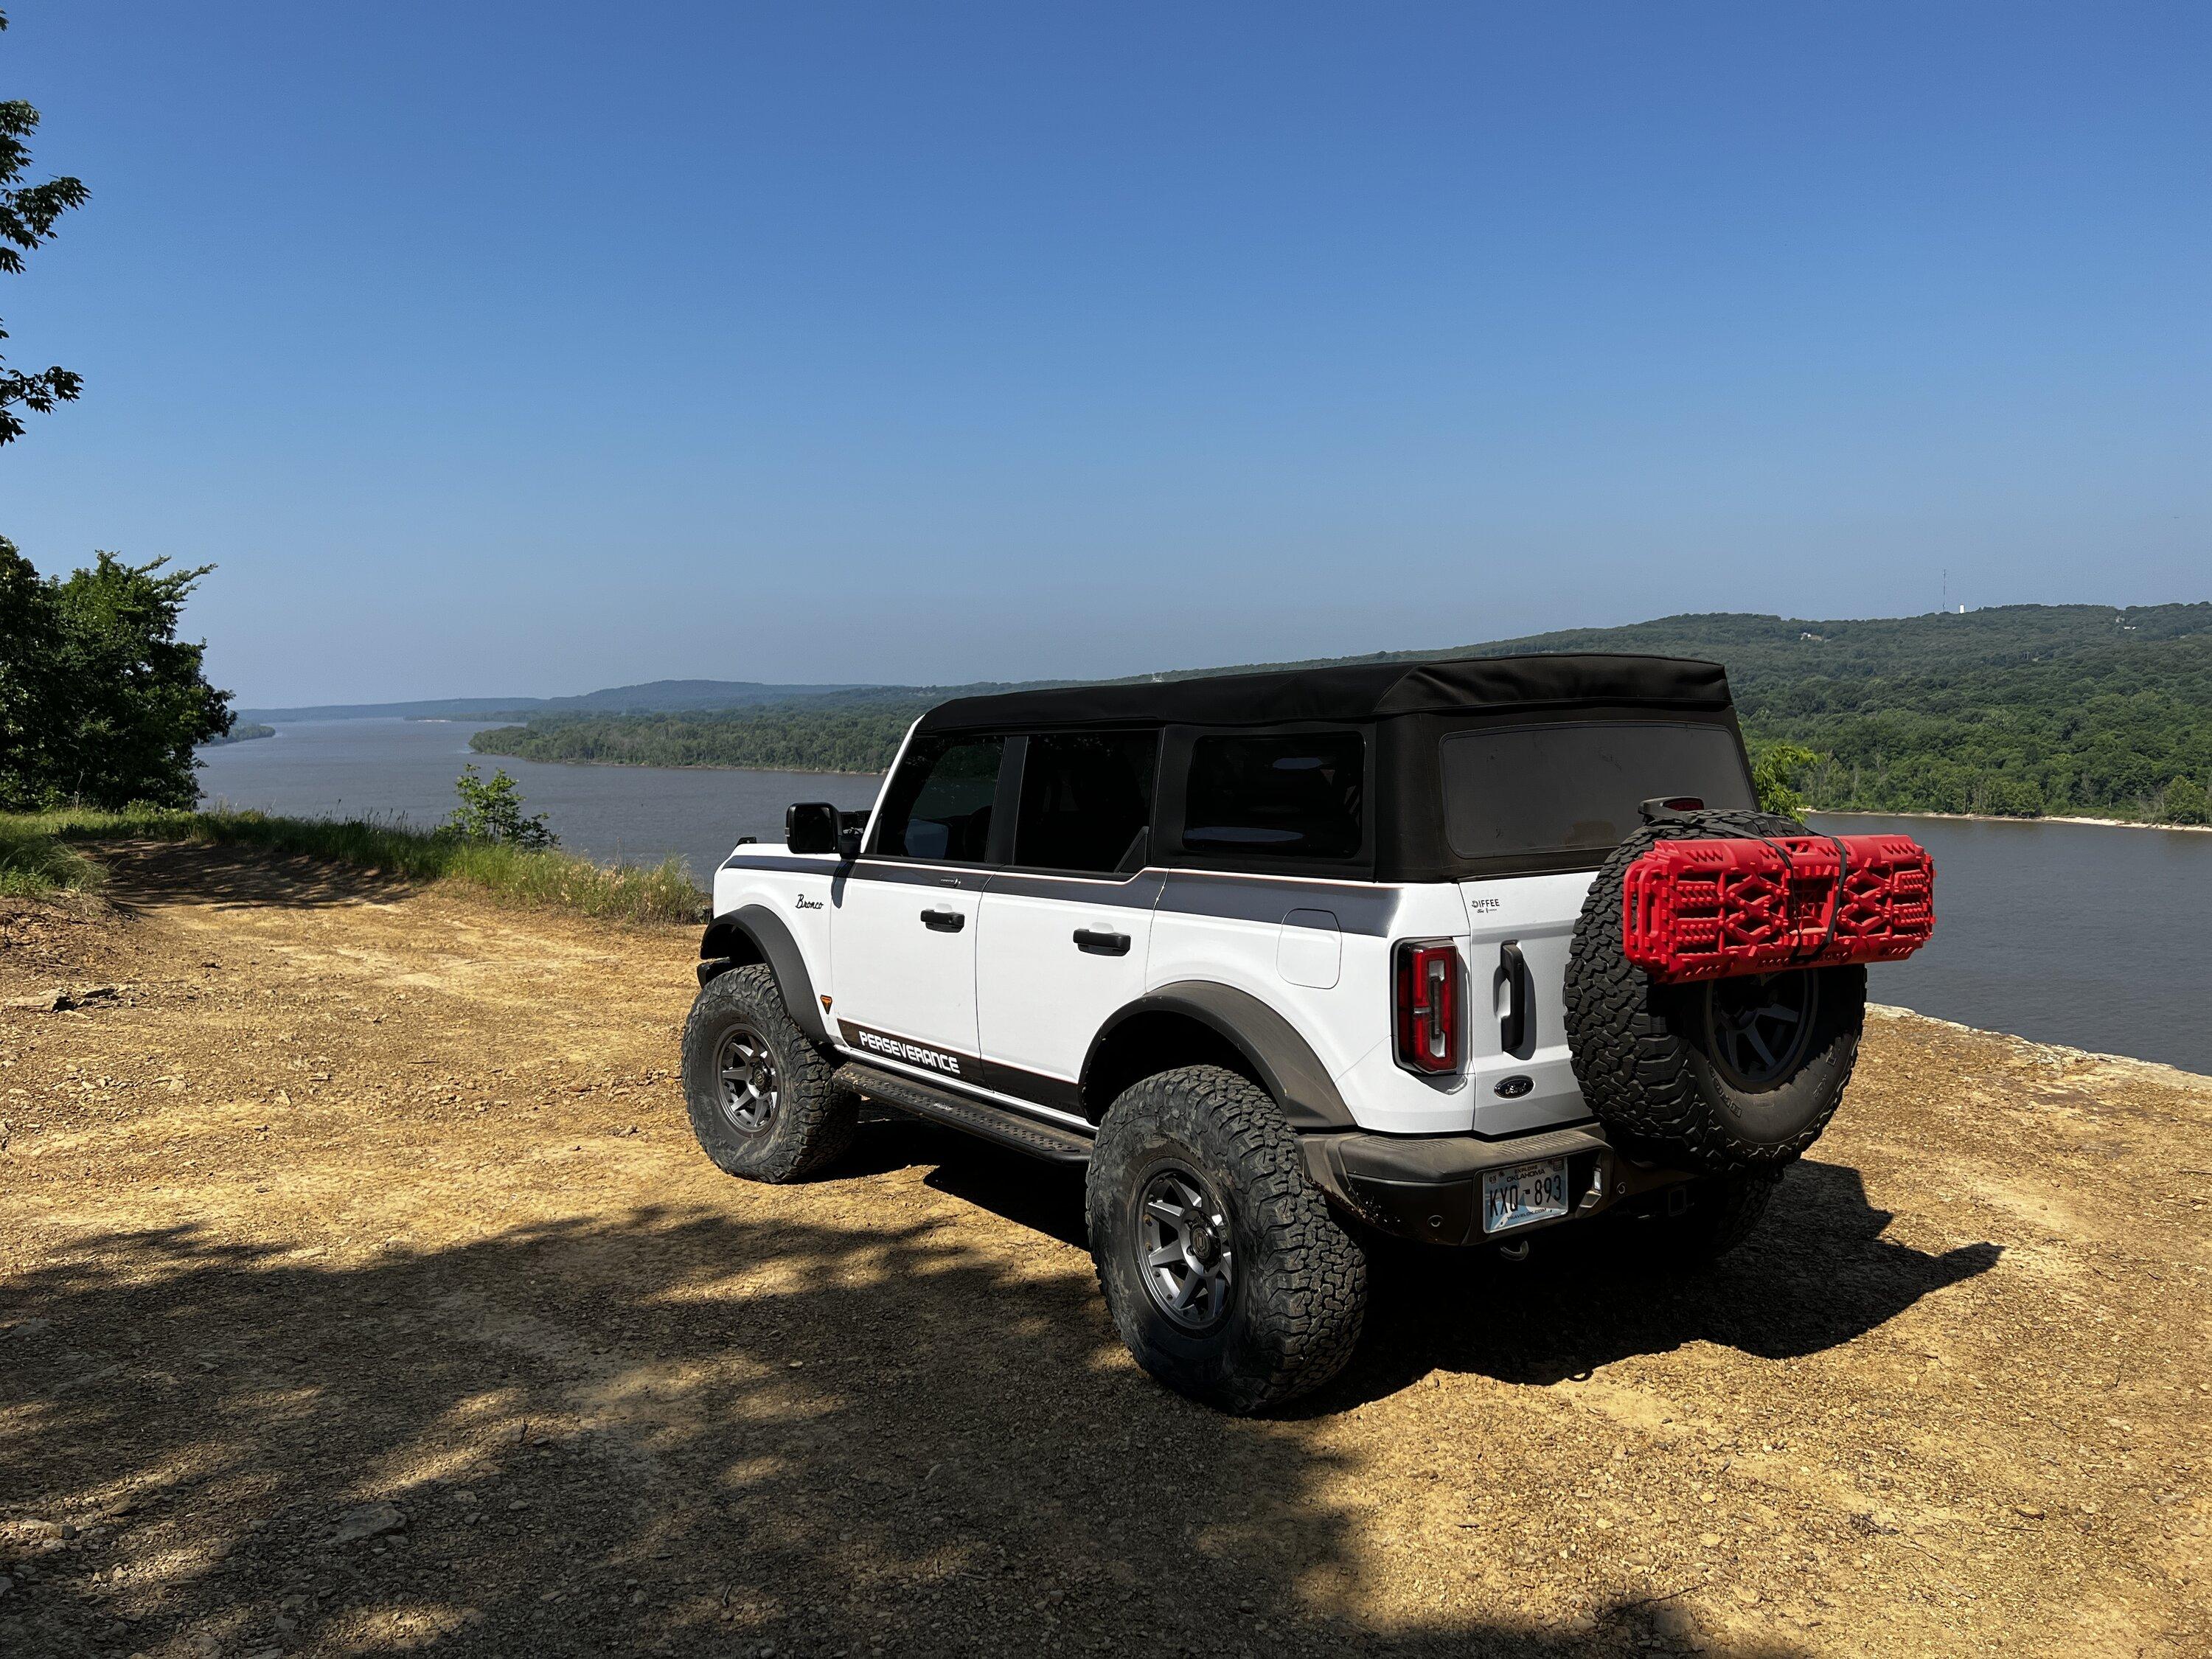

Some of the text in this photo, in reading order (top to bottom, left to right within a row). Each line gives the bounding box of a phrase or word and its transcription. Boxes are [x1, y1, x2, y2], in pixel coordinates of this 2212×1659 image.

[795, 894, 824, 909] Bronco
[1471, 899, 1500, 908] DIFFEE
[859, 1031, 961, 1074] PERSEVERANCE
[1506, 1169, 1545, 1183] OKLAHOMA
